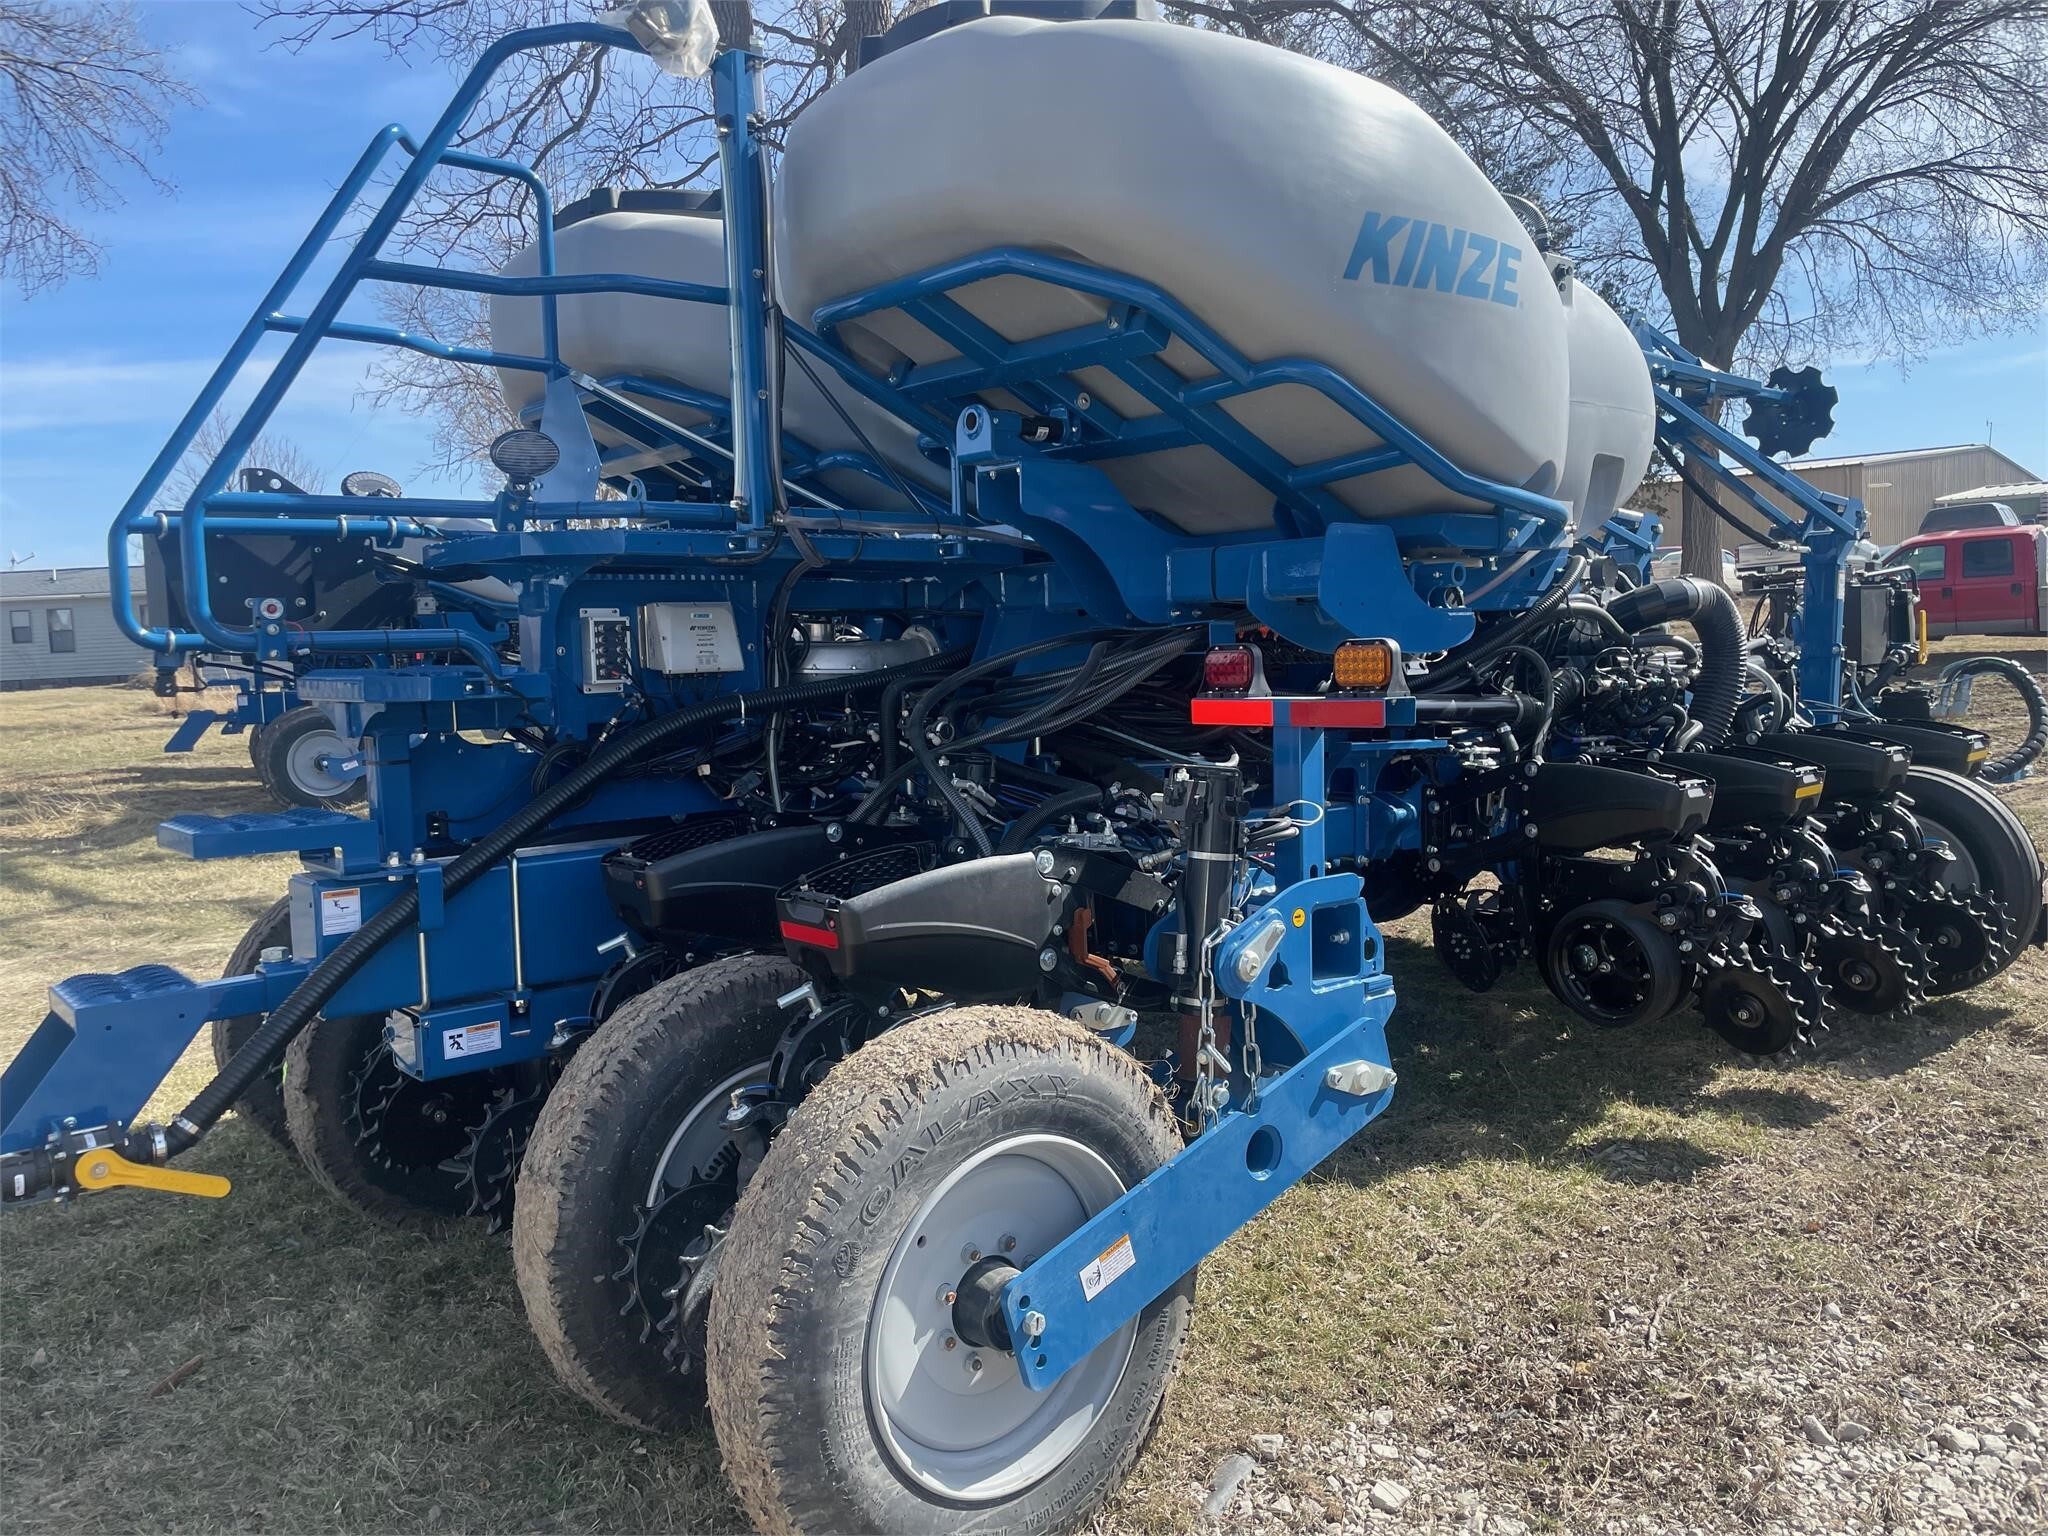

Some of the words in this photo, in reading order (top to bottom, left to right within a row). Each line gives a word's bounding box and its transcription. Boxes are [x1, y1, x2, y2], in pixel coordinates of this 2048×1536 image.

[1343, 211, 1522, 308] KINZE
[857, 1073, 1081, 1228] GALAXY
[1147, 1307, 1169, 1371] HIGHWAY
[1125, 1379, 1149, 1424] TREAD
[1102, 1429, 1122, 1460] FOR
[1022, 1461, 1098, 1531] AGRICULTURAL
